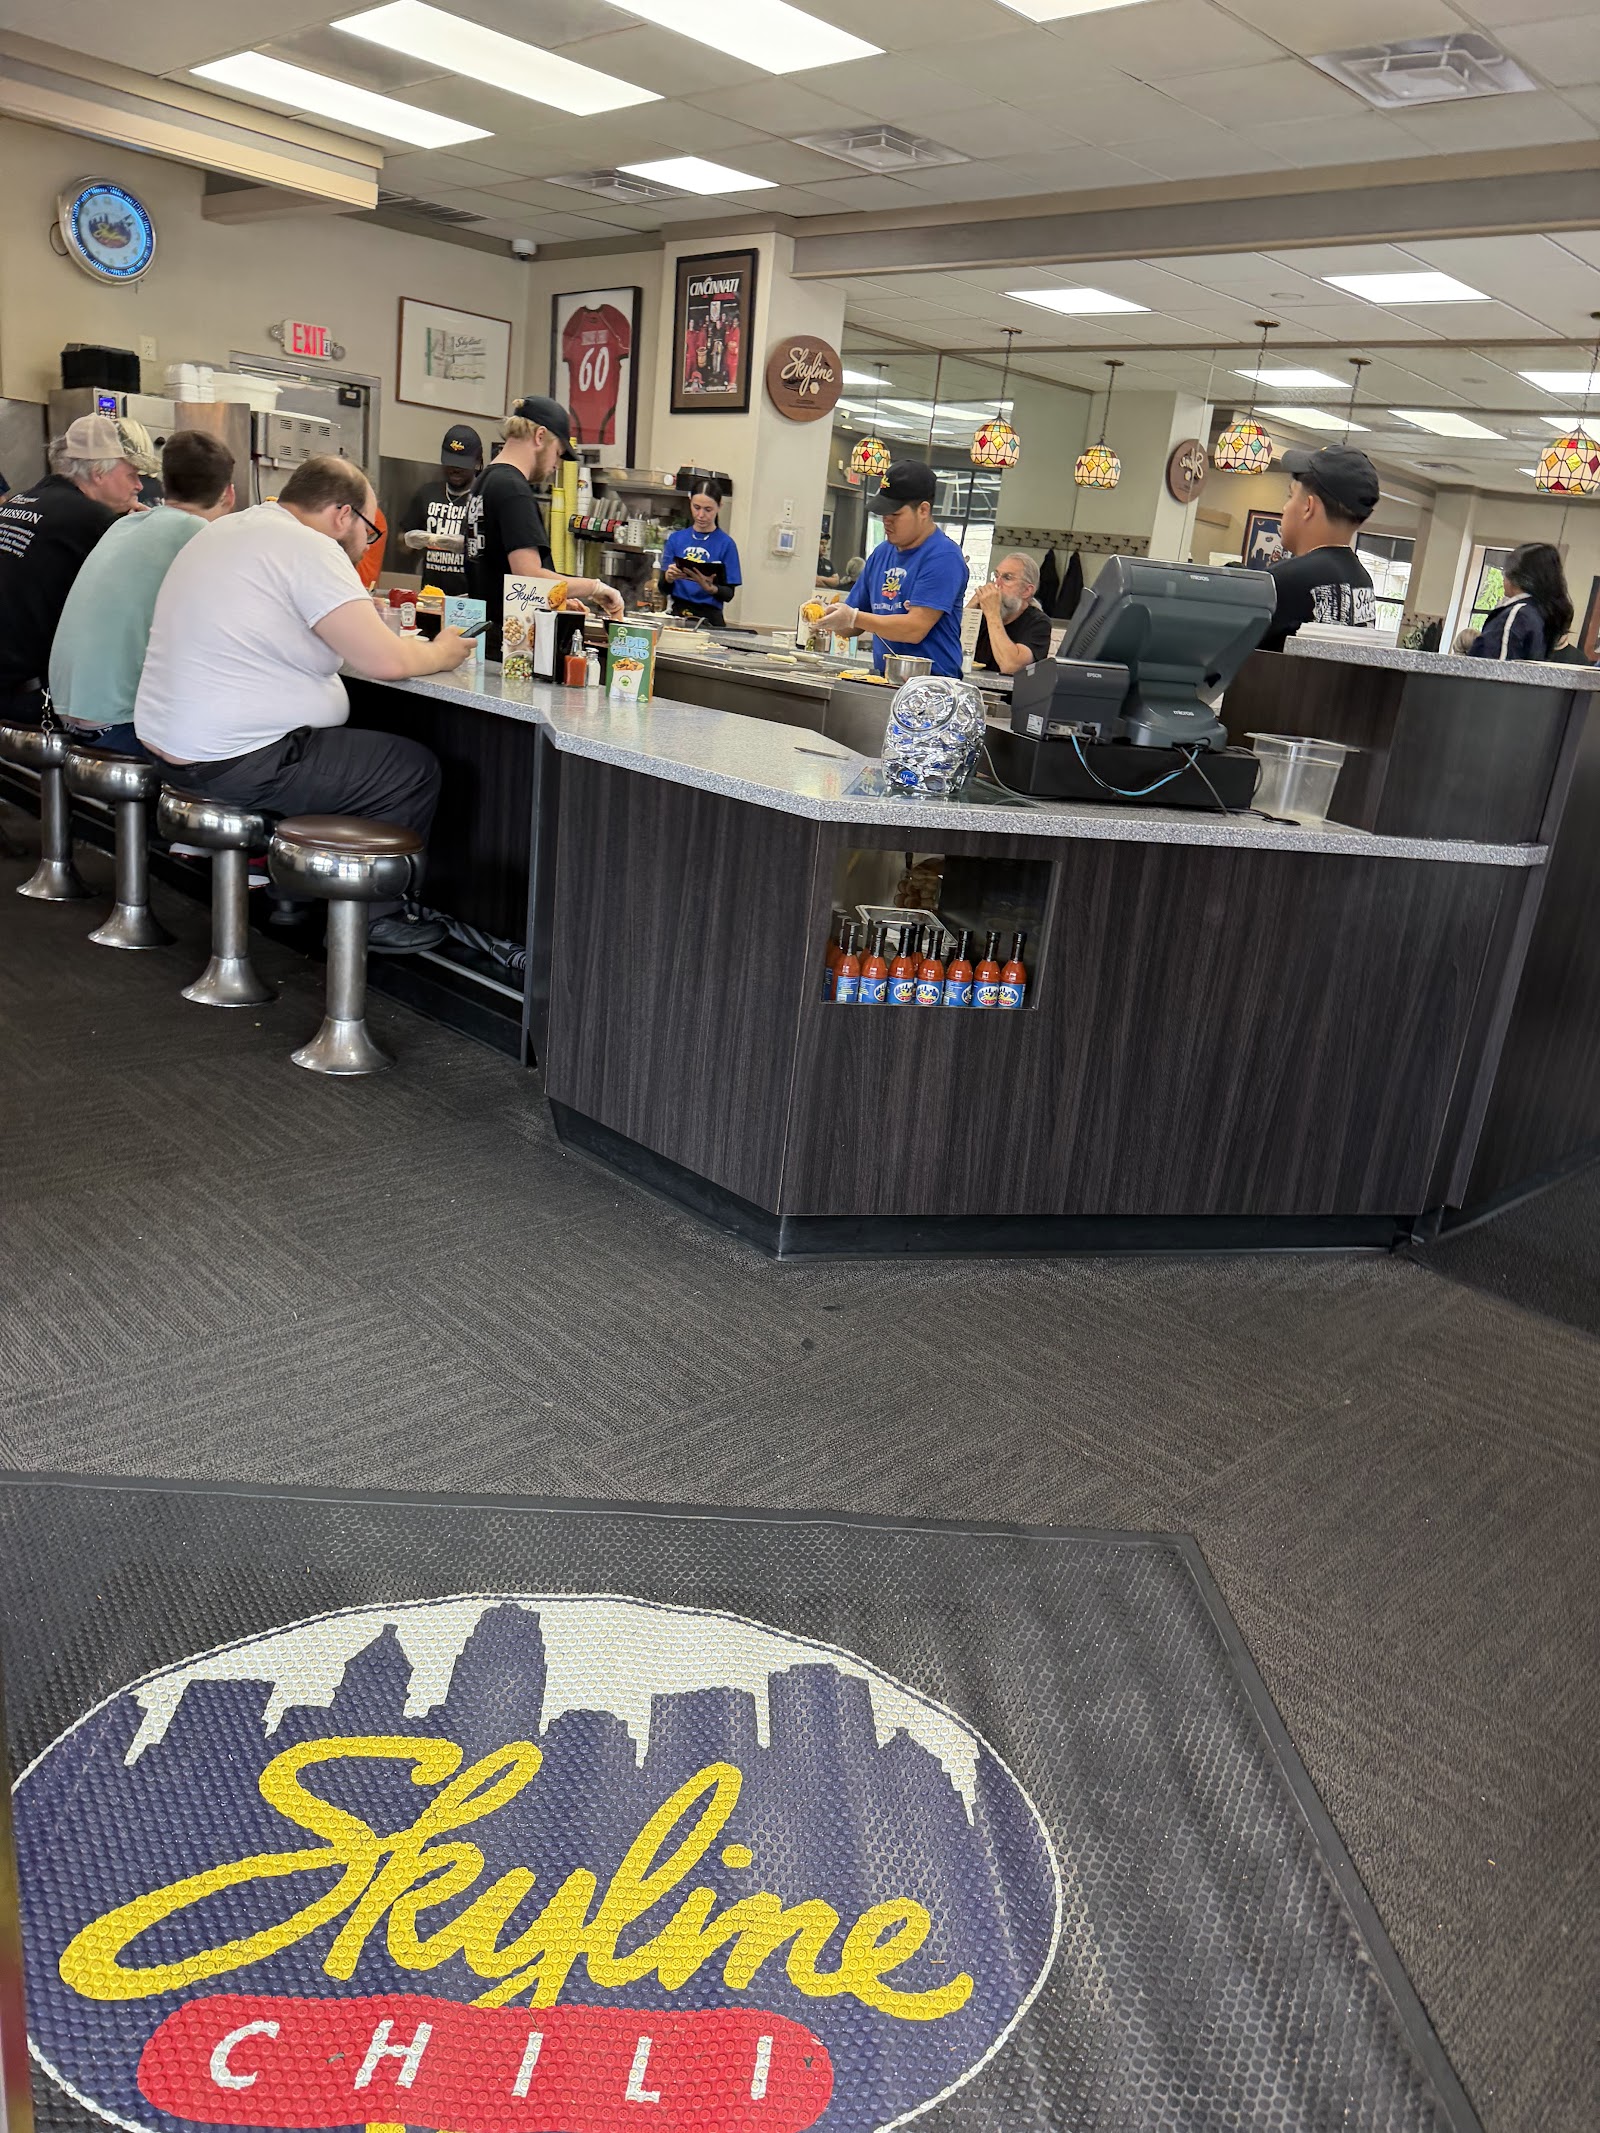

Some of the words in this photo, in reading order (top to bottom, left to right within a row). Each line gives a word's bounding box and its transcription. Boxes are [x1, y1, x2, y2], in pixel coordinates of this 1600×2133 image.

[690, 276, 740, 296] CINCINNATI
[293, 323, 326, 357] EXIT
[579, 346, 609, 391] 60
[781, 347, 834, 396] Skyline
[427, 501, 467, 520] OFFICIA
[506, 583, 546, 611] Skyline
[60, 1735, 973, 2020] Skyline
[209, 2019, 773, 2103] CHILI
